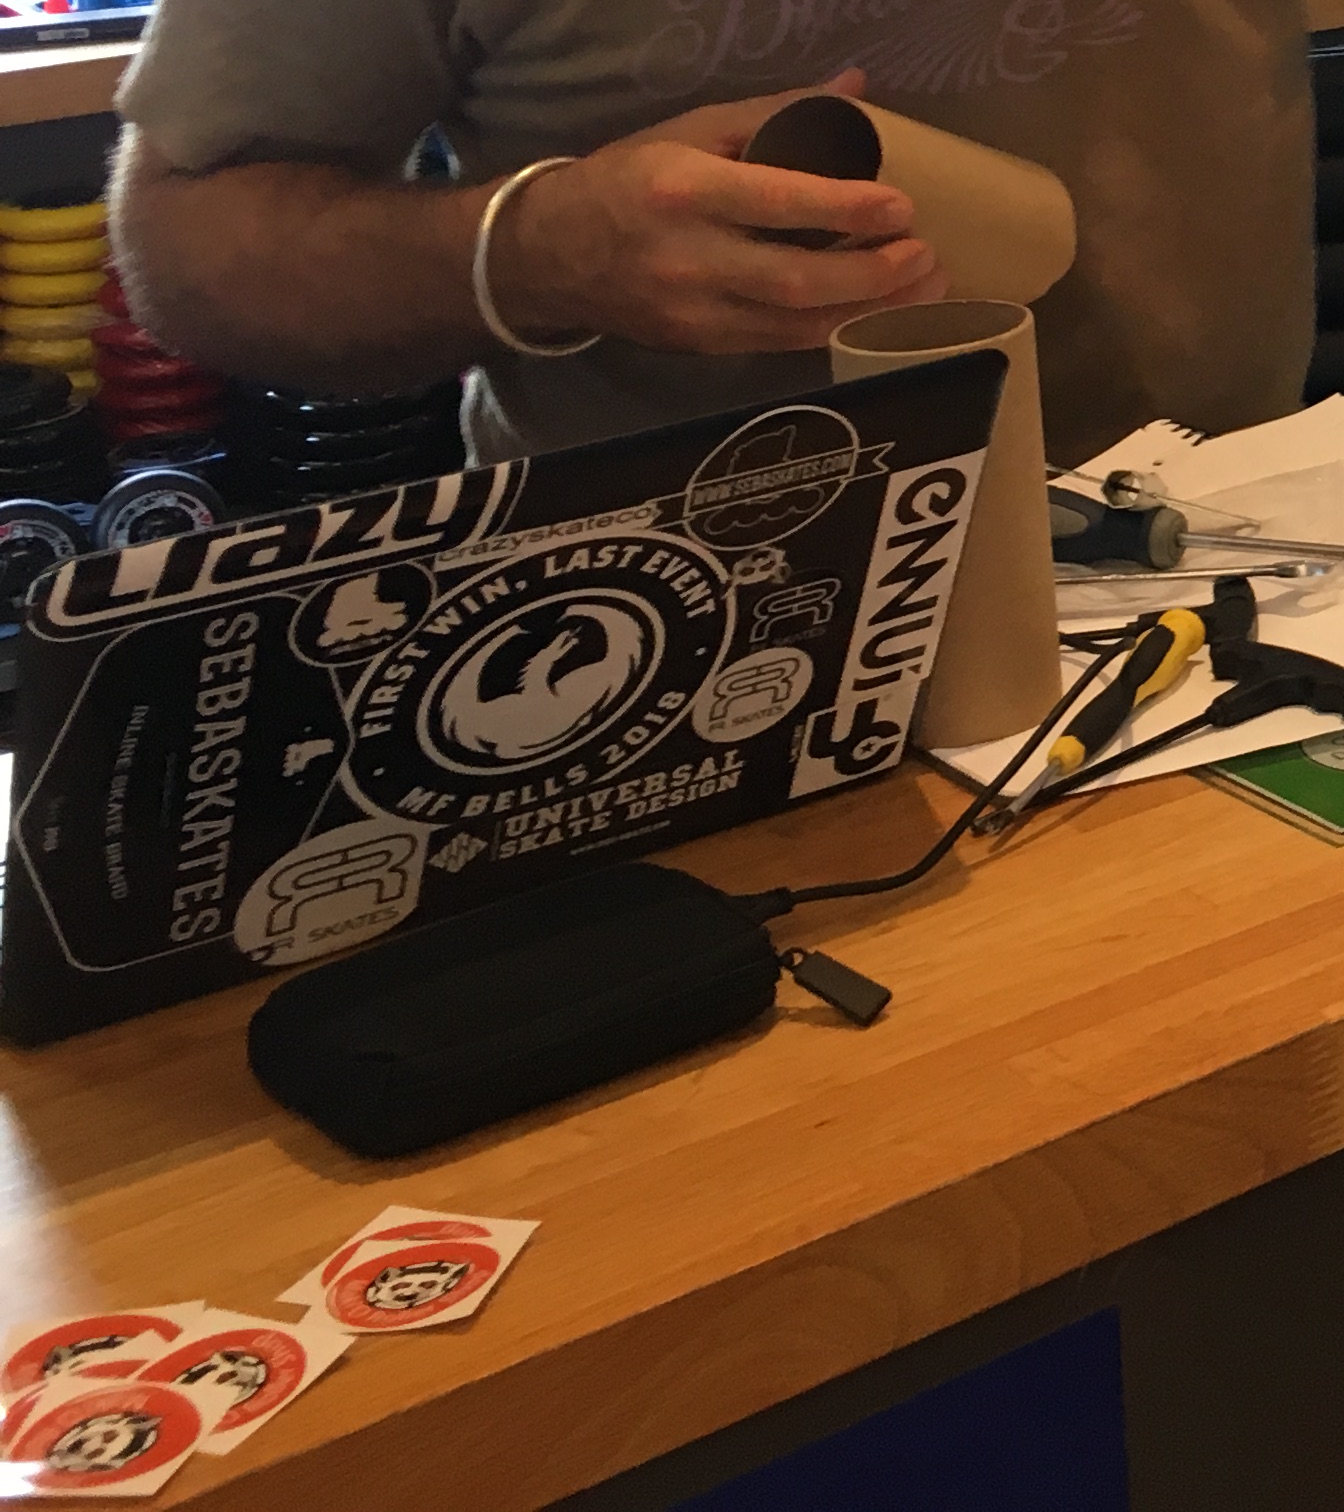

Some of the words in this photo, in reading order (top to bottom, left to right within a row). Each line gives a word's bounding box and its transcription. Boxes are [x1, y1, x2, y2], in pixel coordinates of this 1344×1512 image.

[360, 641, 432, 740] FIRST
[543, 544, 645, 580] LAST
[641, 548, 718, 620] EVENT
[169, 610, 261, 944] SEBASKATES
[459, 762, 592, 818] BELLS
[599, 690, 688, 766] 2018
[499, 810, 614, 859] SKATE
[624, 769, 744, 821] DESIGN
[504, 748, 748, 839] UNIVERSAL
